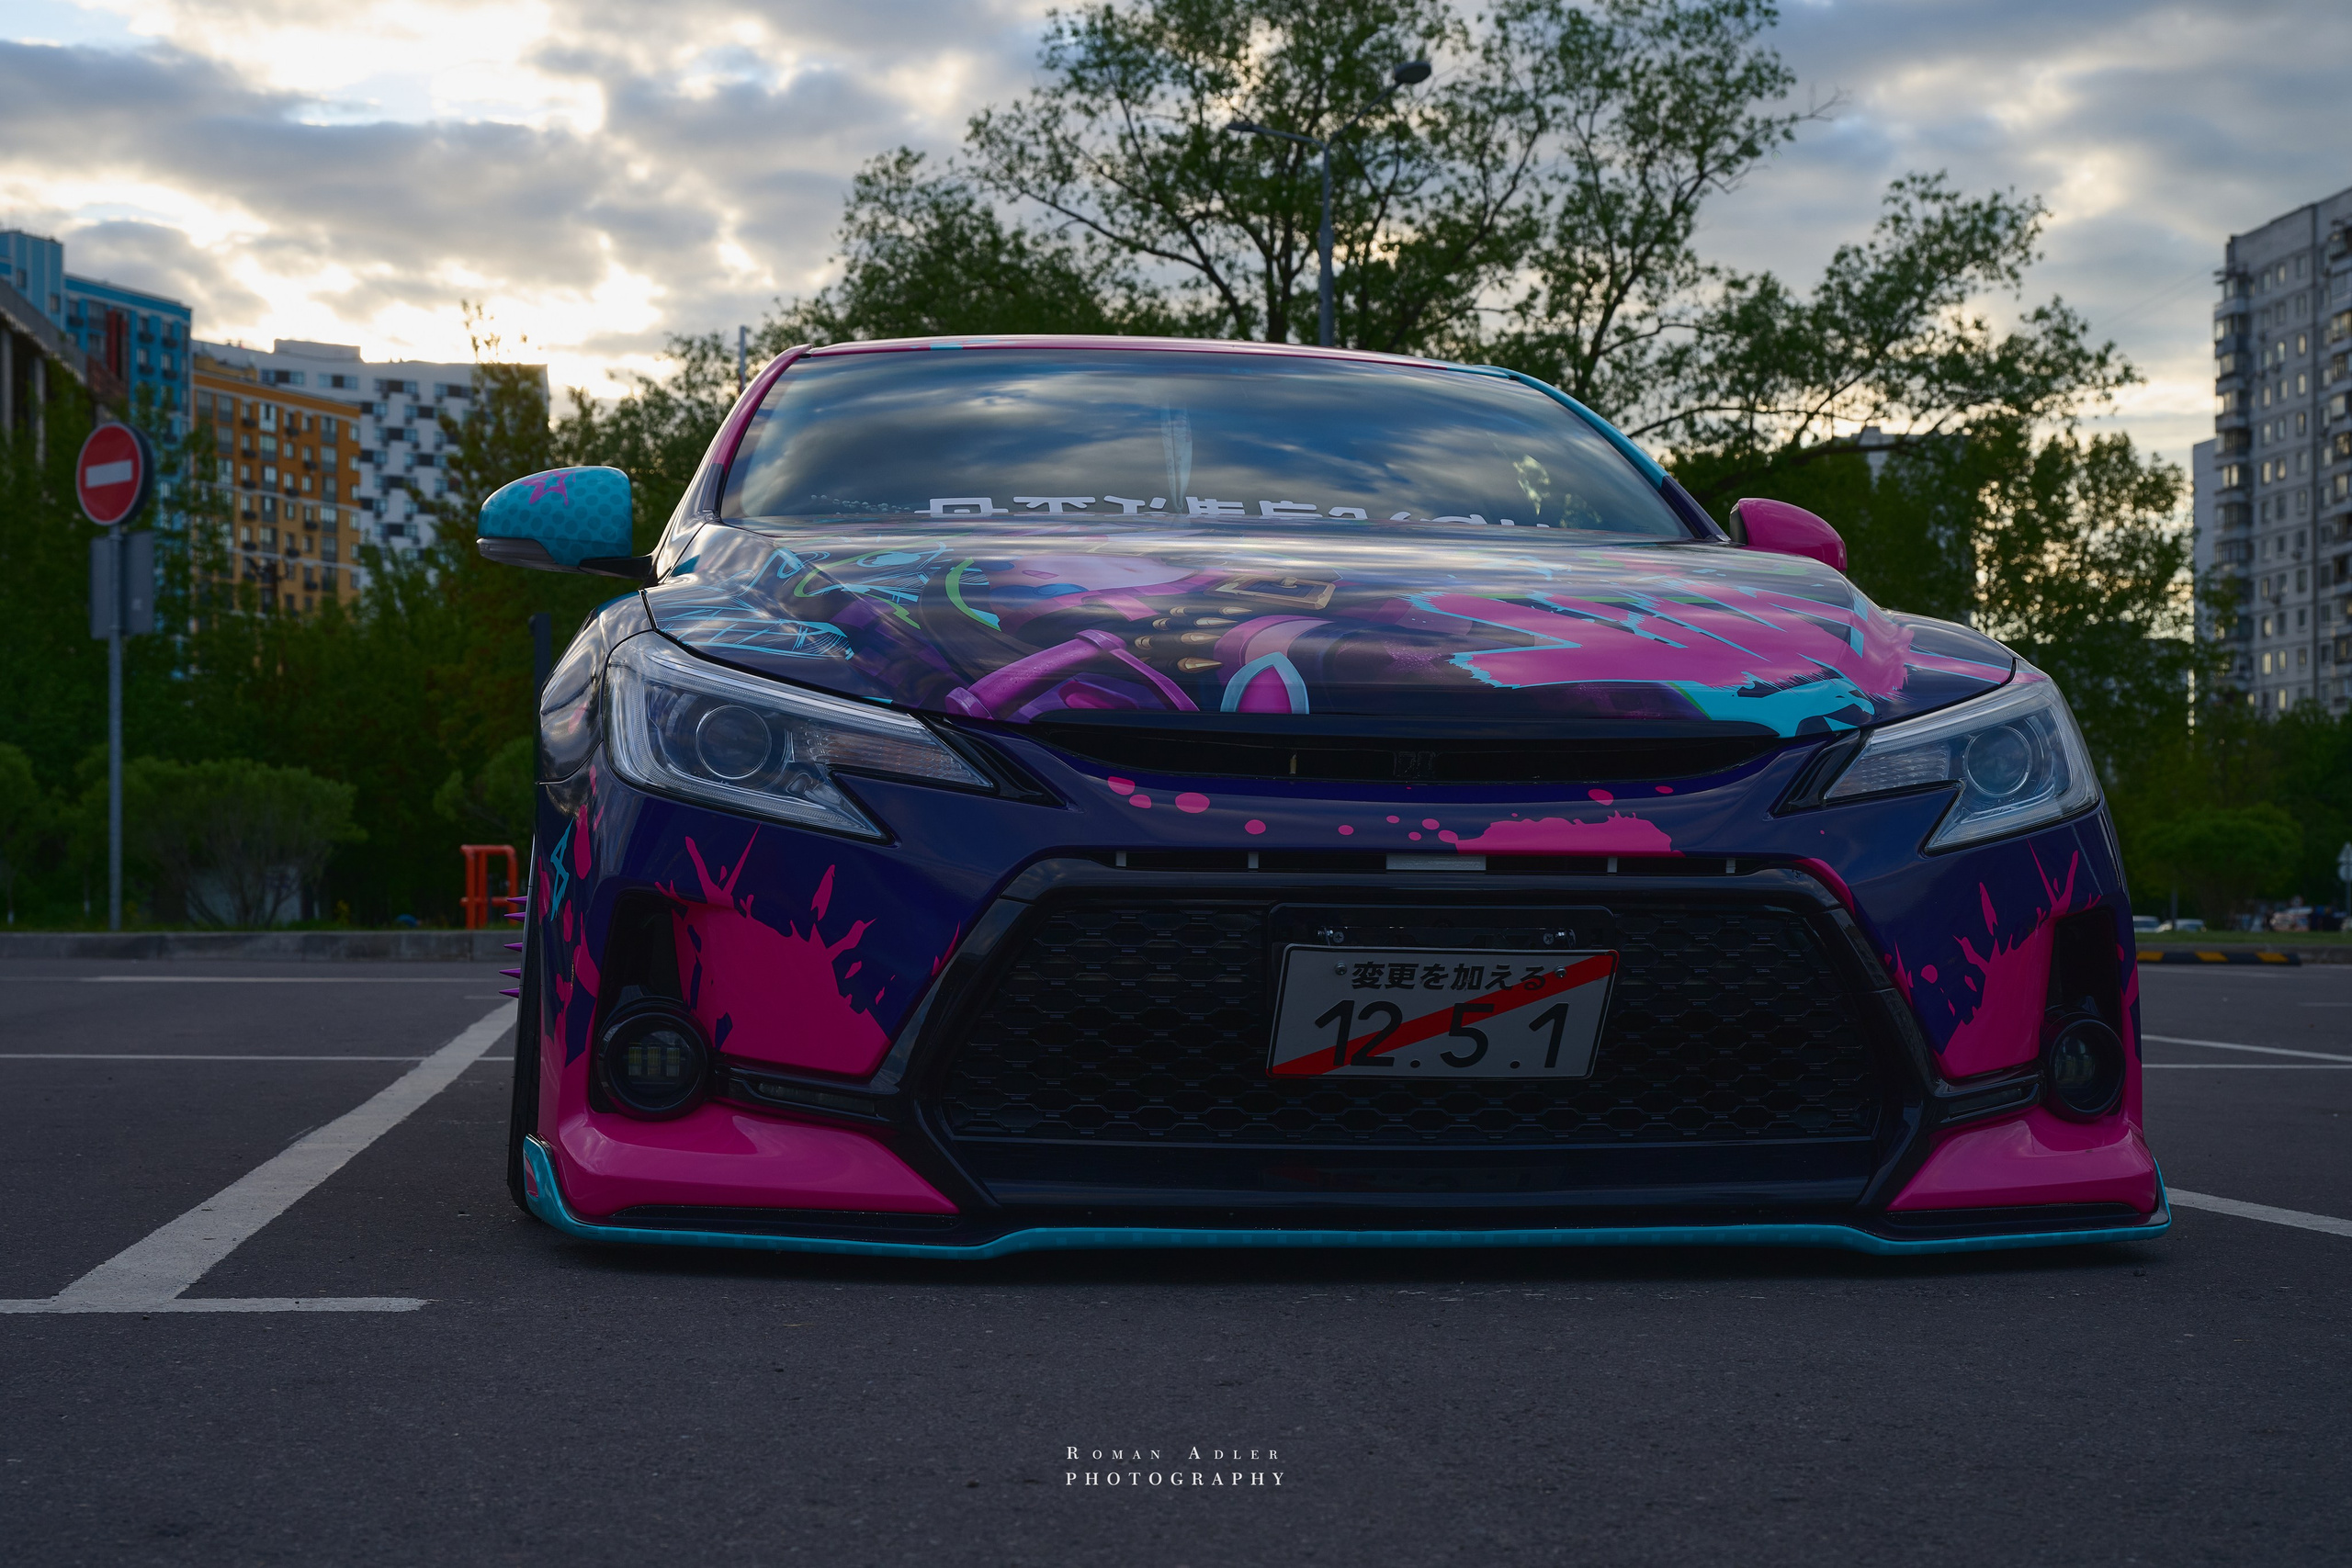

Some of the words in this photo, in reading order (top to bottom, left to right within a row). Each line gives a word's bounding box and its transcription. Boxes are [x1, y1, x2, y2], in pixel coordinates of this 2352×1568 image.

[1351, 961, 1547, 991] 変更を加える
